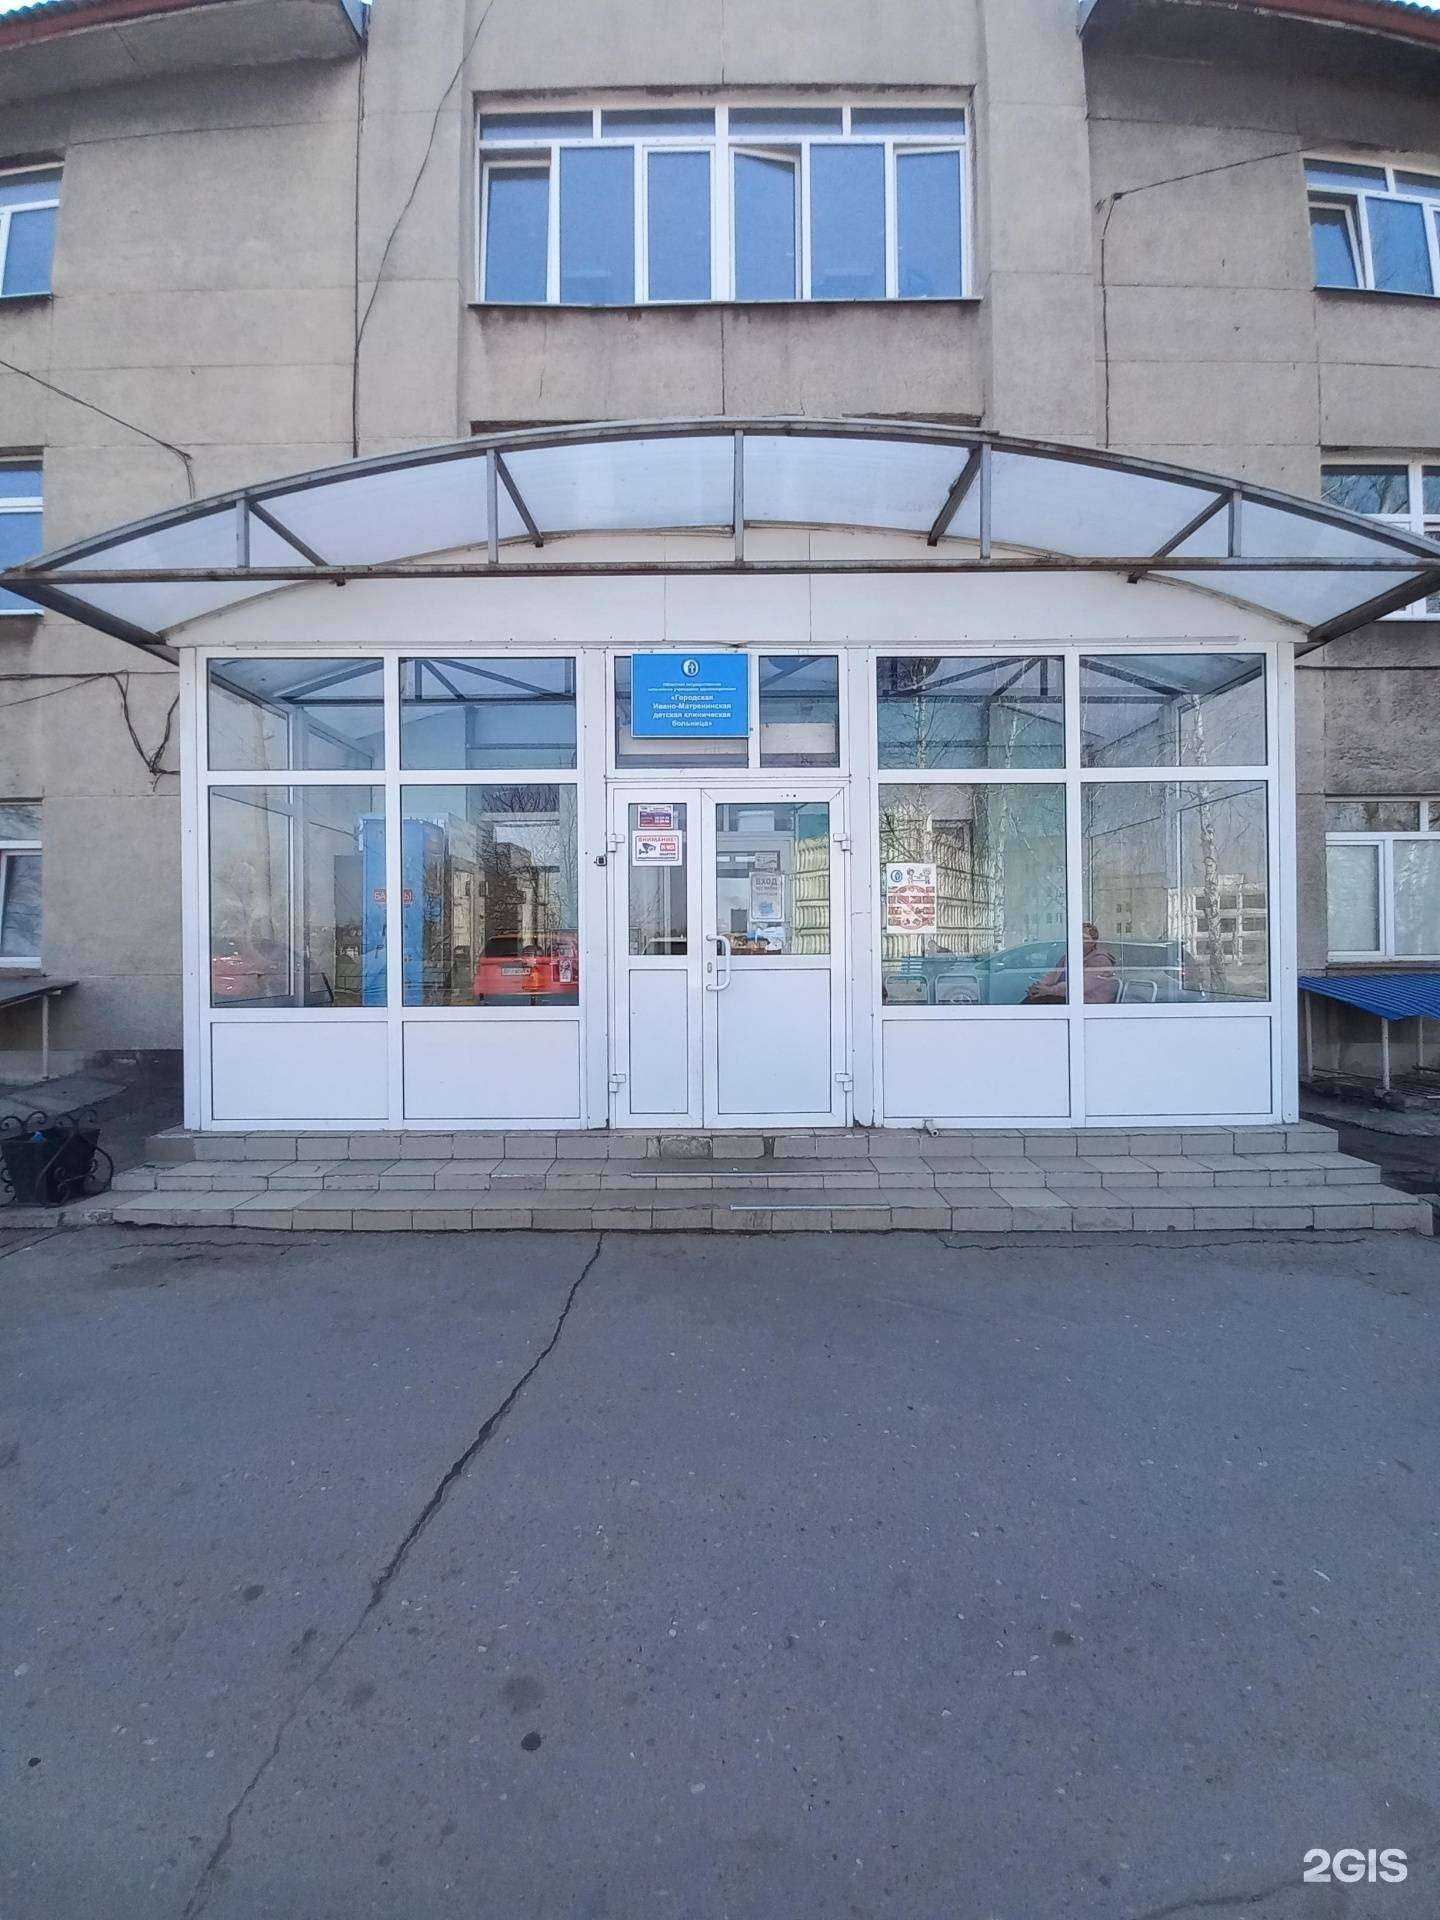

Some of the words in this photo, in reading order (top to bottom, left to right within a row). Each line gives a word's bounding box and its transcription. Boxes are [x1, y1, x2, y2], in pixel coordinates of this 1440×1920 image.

[671, 694, 713, 702] «Городская
[653, 703, 732, 711] Ивано-Матренинская
[755, 878, 778, 886] ВХОД
